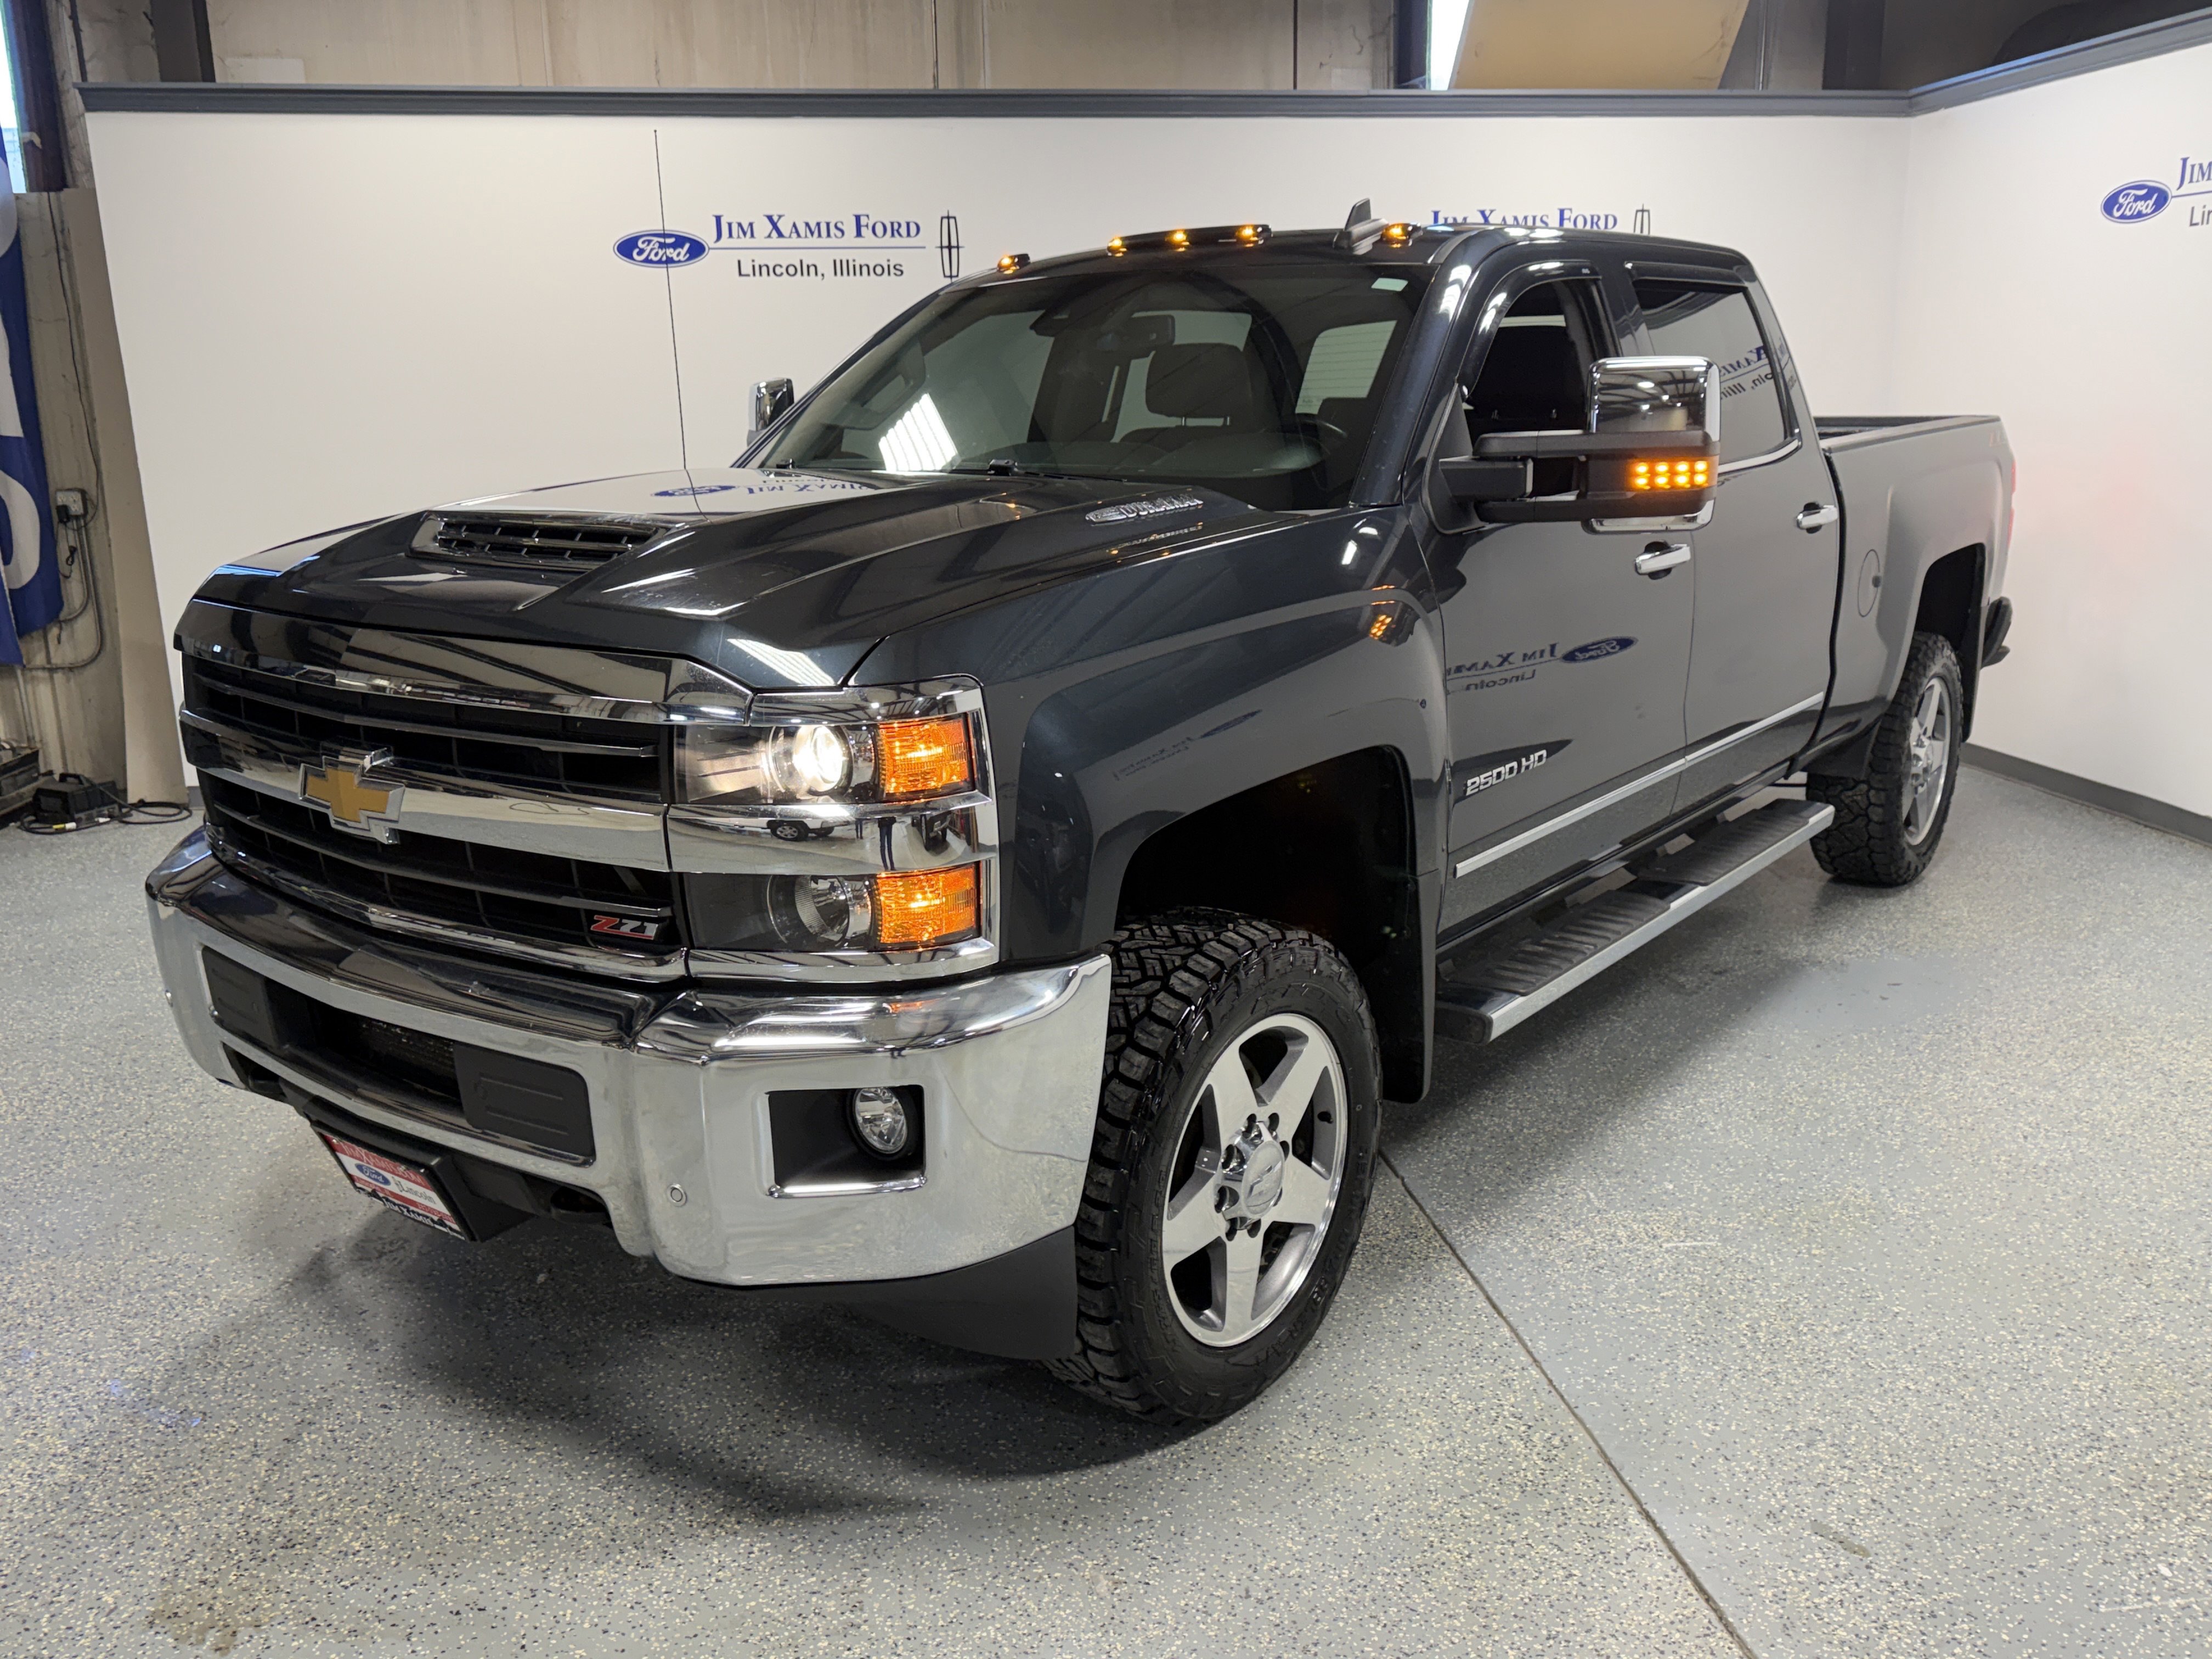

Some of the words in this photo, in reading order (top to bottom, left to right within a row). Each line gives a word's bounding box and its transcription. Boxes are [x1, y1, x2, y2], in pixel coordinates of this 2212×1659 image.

[2113, 188, 2158, 217] Ford
[712, 214, 755, 244] JIM
[763, 214, 845, 239] XAMIS
[853, 214, 921, 239] FORD
[633, 236, 690, 262] Ford
[737, 259, 825, 281] Lincoln,
[833, 259, 904, 277] Illinois
[1466, 760, 1518, 796] 2500
[1521, 749, 1547, 773] HD
[590, 915, 658, 940] Z71
